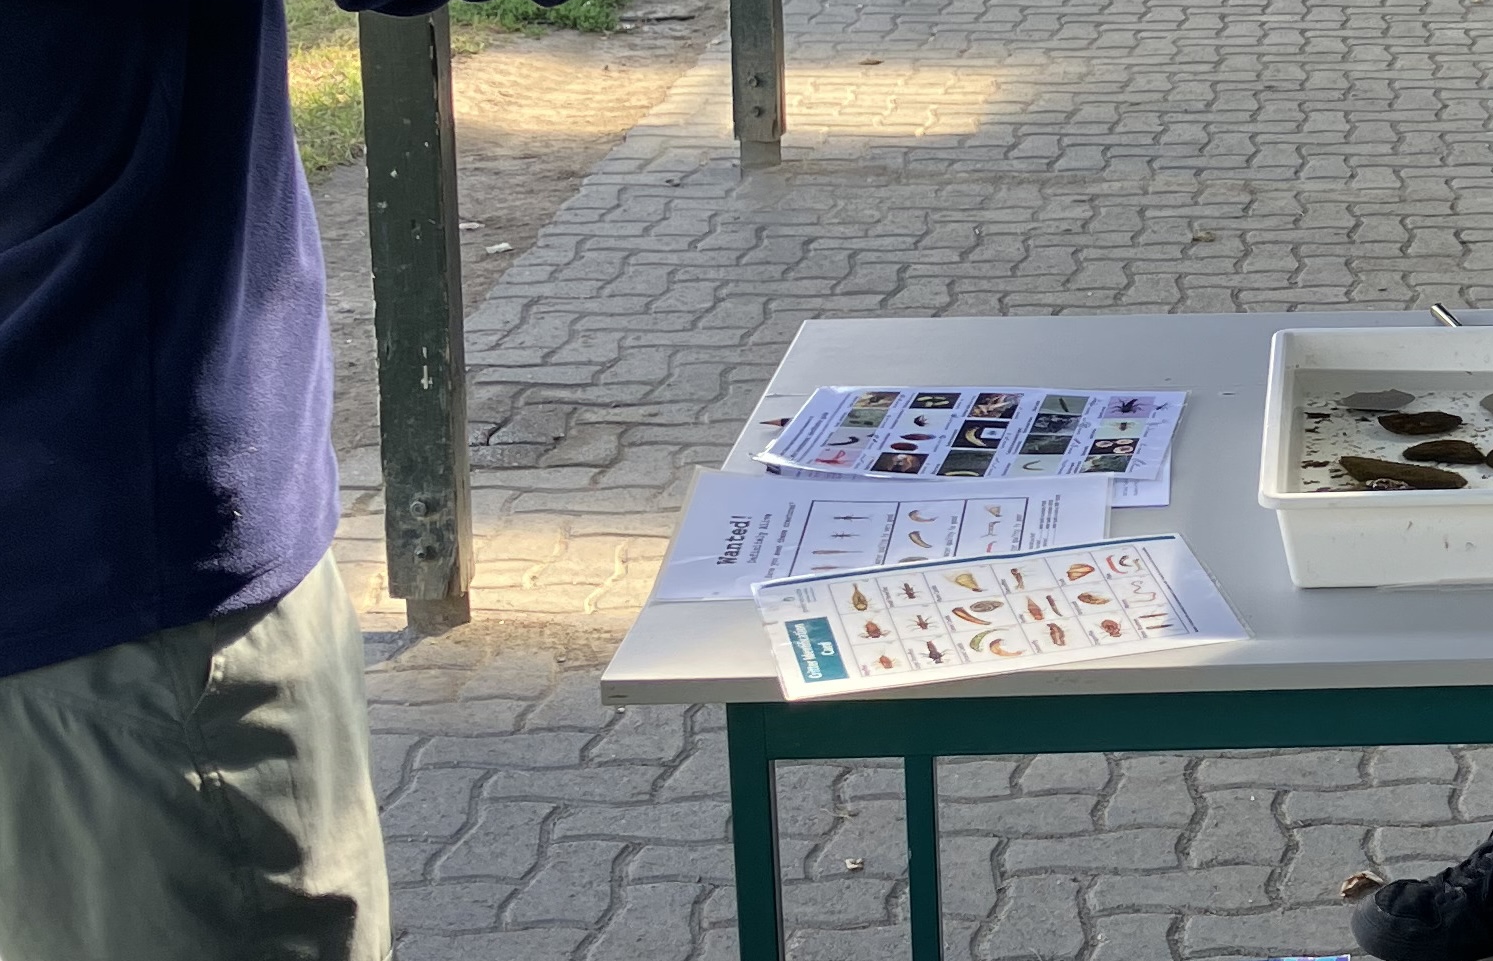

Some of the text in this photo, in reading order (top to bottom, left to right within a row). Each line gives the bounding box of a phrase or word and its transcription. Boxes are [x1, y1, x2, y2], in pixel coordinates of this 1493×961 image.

[758, 513, 772, 529] Alive
[716, 515, 752, 565] Wanted!
[792, 623, 816, 660] Identification
[817, 642, 835, 656] Card
[807, 660, 822, 678] Critter
